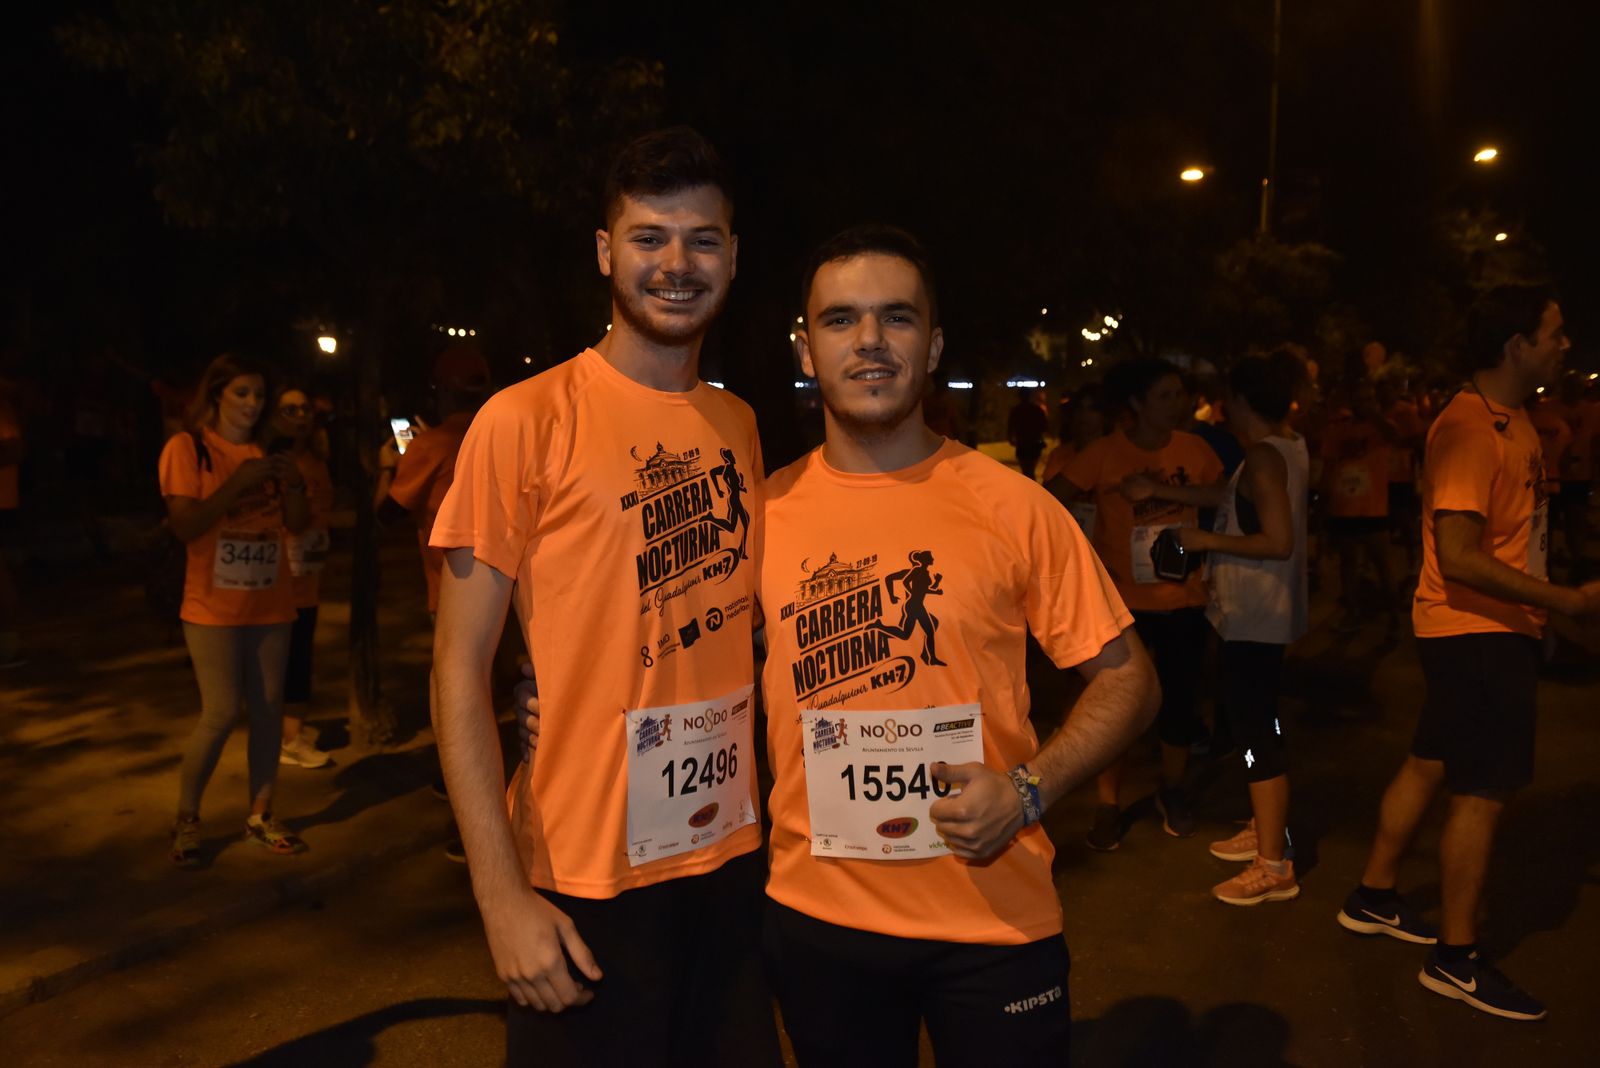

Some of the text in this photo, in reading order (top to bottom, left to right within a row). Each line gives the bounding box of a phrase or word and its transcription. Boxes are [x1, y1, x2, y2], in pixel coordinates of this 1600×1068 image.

[620, 490, 640, 512] XXXI
[641, 477, 714, 540] CARRERA
[221, 543, 277, 565] 3442
[636, 522, 721, 591] NOCTURNA
[781, 602, 795, 622] XXXI
[796, 584, 883, 649] CARRERA
[792, 630, 892, 697] NOCTURNA
[870, 664, 906, 690] KH-7
[636, 733, 660, 753] NOCTURNA
[639, 723, 660, 740] CARRERA
[813, 737, 837, 750] NOCTURNA
[814, 727, 835, 739] CARRERA
[860, 718, 923, 744] NO8DO
[662, 743, 738, 798] 12496
[1010, 986, 1062, 1014] KIPSTA
